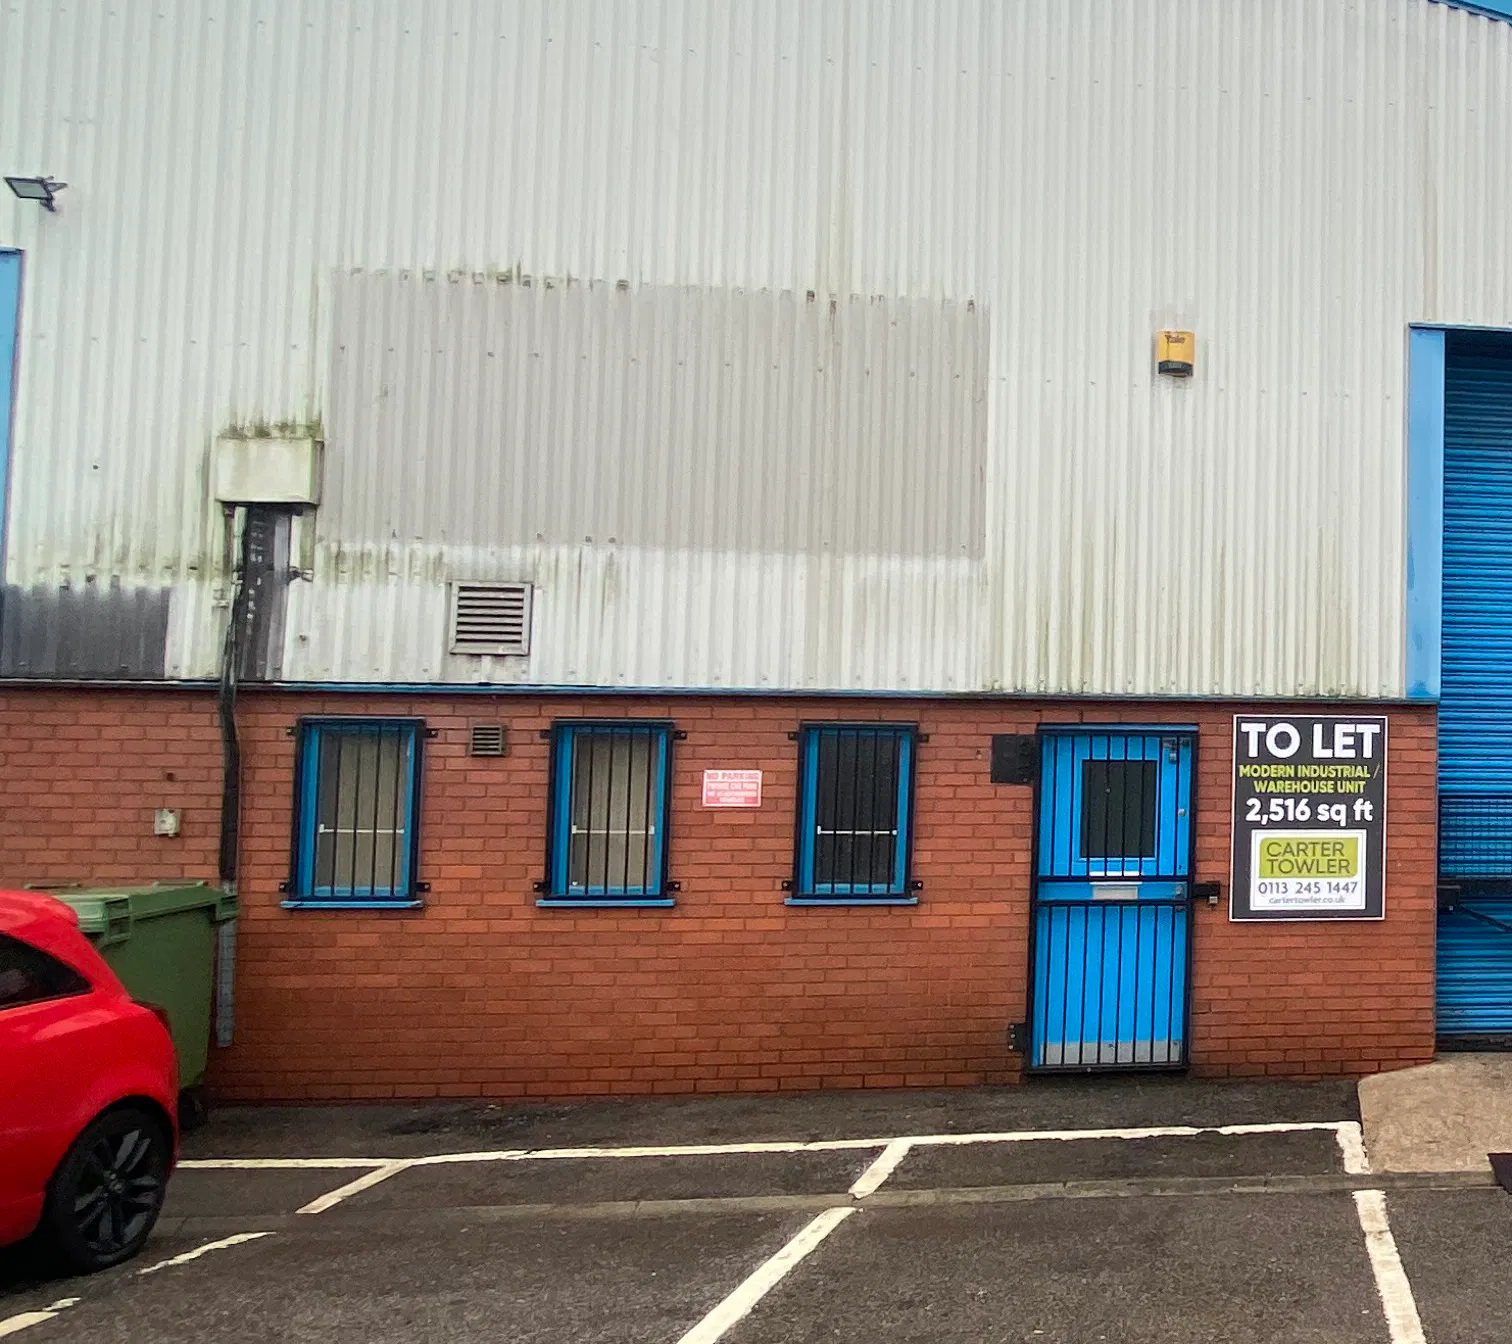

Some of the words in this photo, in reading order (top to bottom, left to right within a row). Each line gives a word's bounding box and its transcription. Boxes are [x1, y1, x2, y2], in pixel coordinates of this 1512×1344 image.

[1241, 722, 1300, 758] TO
[1313, 723, 1380, 758] LET
[1239, 764, 1294, 778] MODERN
[1297, 764, 1371, 778] INDUSTRIAL
[1254, 780, 1334, 794] WAREHOUSE
[1339, 780, 1366, 794] UNIT
[1245, 798, 1311, 825] 2,516
[1317, 802, 1346, 827] sq
[1353, 798, 1374, 821] ft
[1266, 841, 1345, 857] CARTER
[1267, 859, 1350, 874] TOWLER
[1258, 882, 1288, 894] 0113
[1295, 882, 1321, 894] 245
[1326, 881, 1358, 894] 1447
